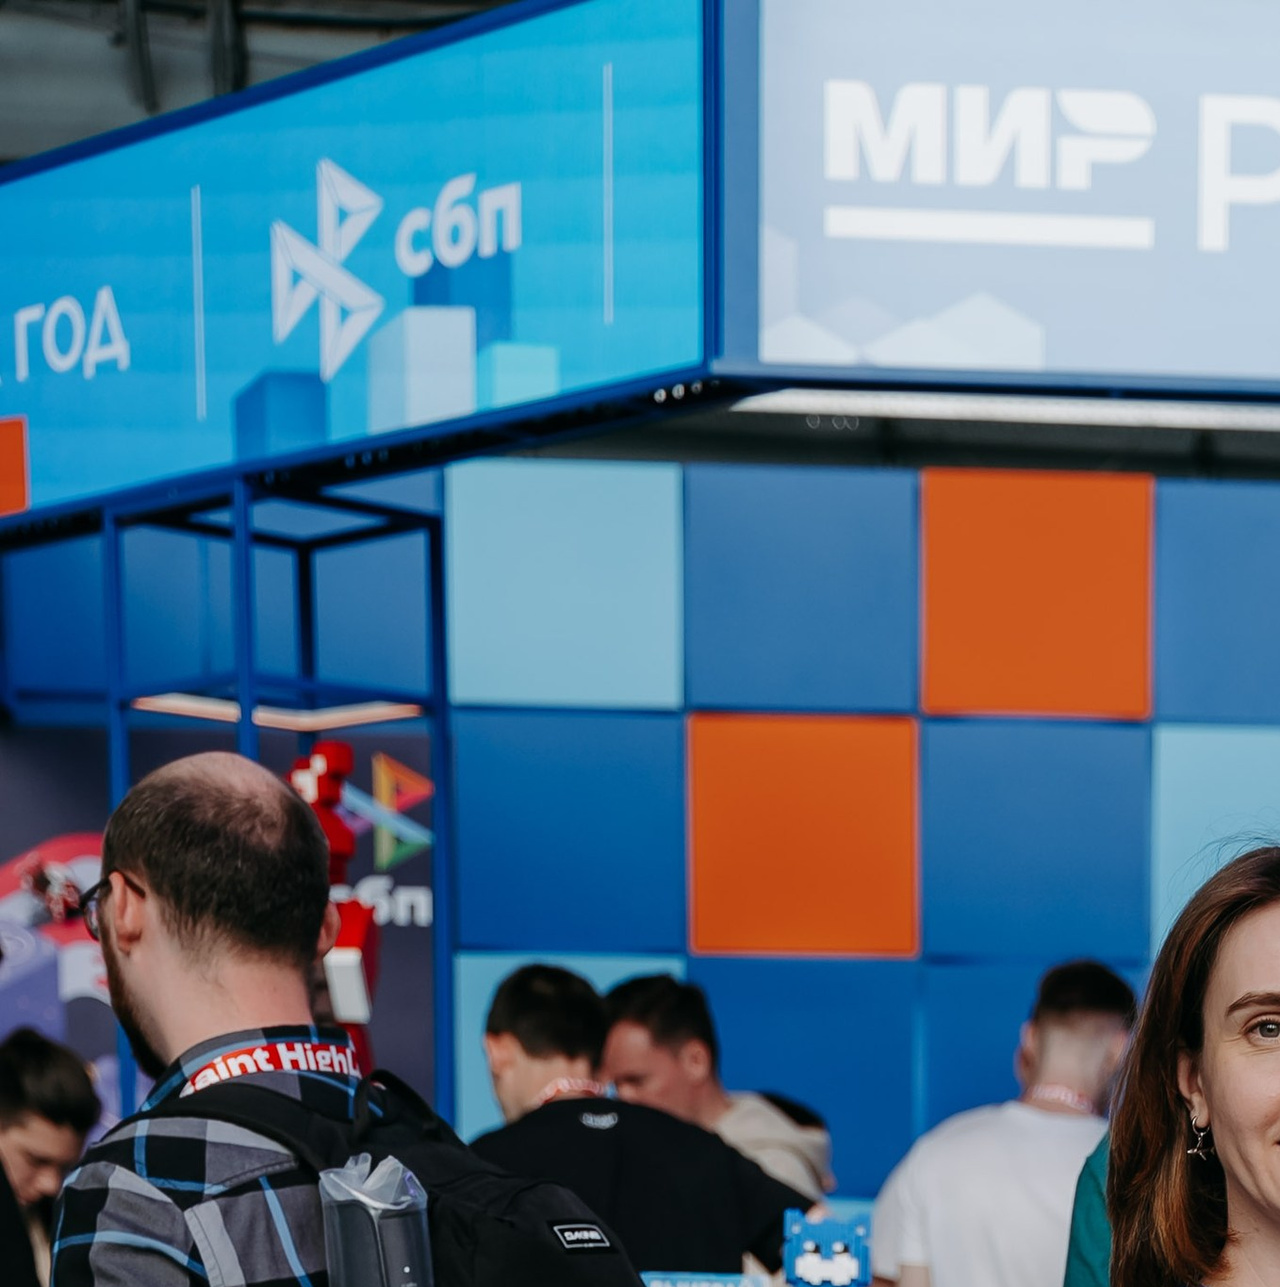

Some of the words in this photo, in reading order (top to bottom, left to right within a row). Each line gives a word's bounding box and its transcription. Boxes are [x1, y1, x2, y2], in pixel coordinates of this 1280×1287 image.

[823, 79, 1157, 190] МИР
[395, 172, 522, 278] сбп
[14, 284, 131, 382] ГОД
